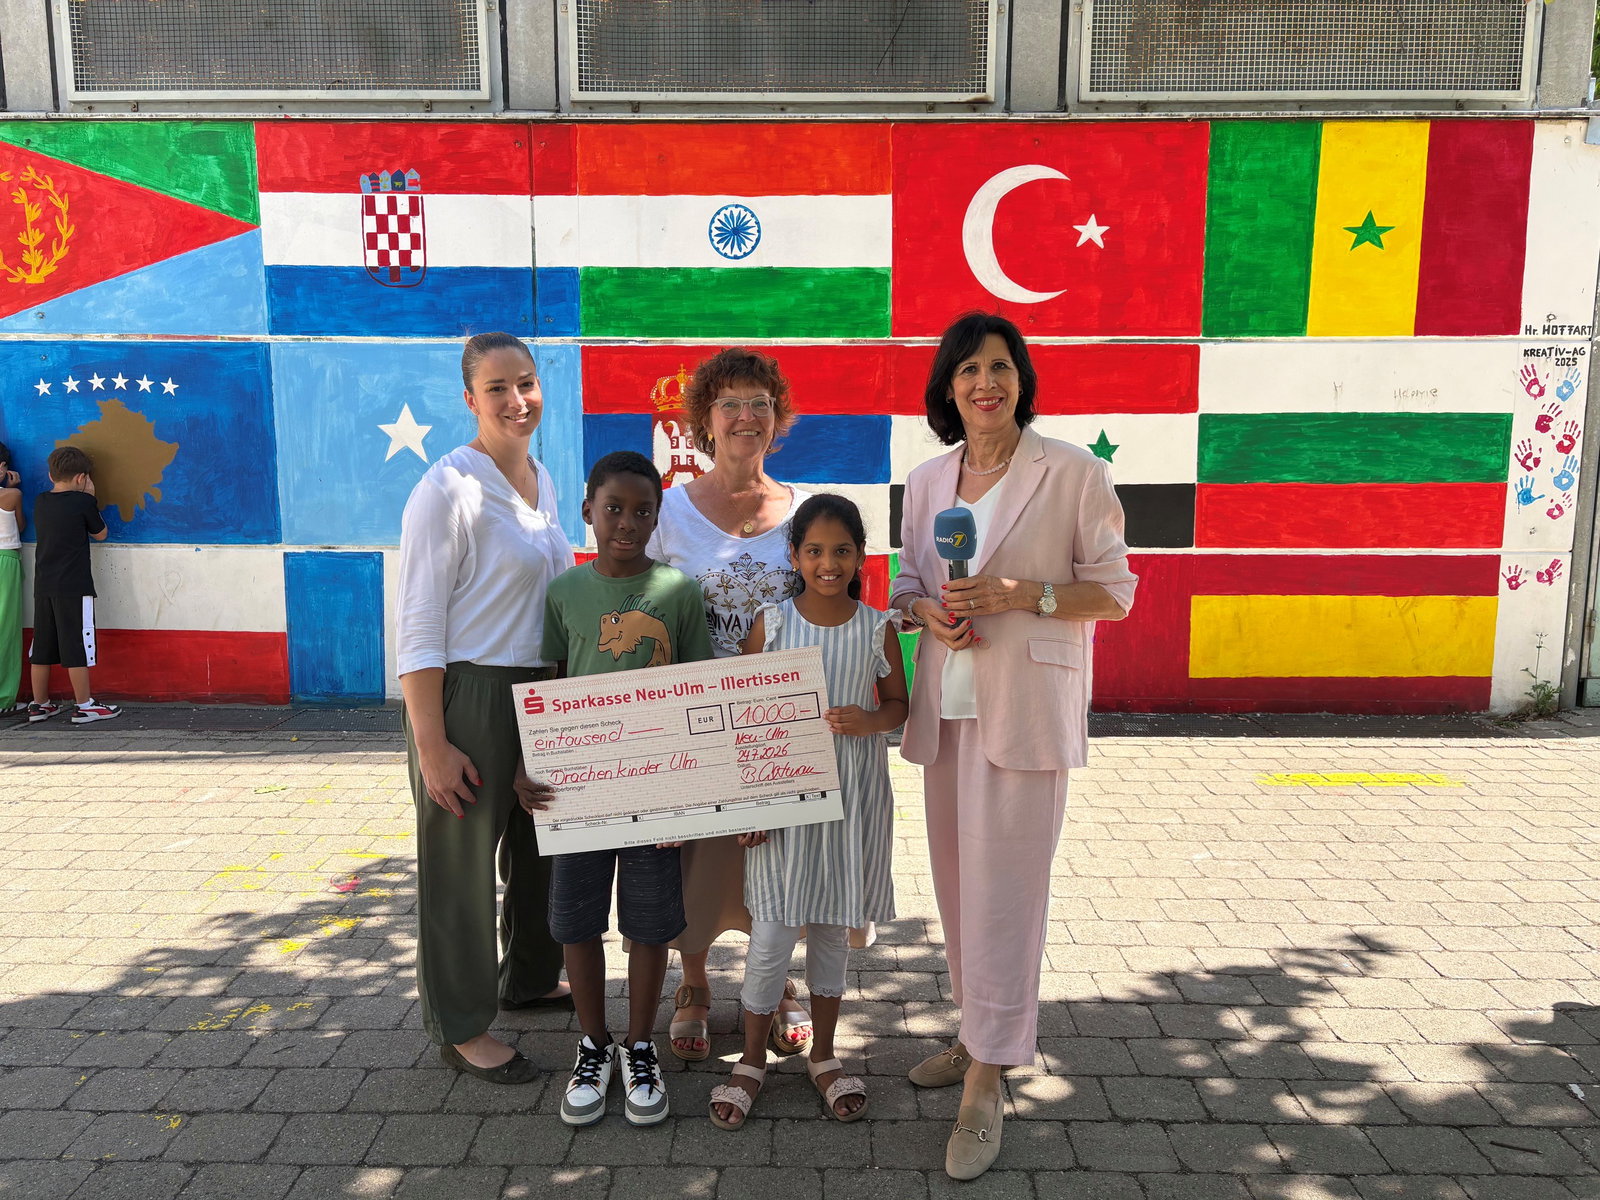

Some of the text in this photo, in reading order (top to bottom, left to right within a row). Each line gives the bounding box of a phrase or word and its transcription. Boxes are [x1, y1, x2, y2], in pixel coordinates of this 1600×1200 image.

[1525, 324, 1538, 336] Hr.
[1555, 357, 1578, 366] 2025
[936, 536, 954, 544] RADIO
[954, 534, 965, 546] 7
[552, 693, 632, 714] Sparkasse
[635, 681, 705, 702] Neu-Ulm
[720, 670, 801, 691] Illertissen
[698, 715, 714, 724] EUR
[528, 719, 621, 736] Zahlen Sie gegen diesen Scheck
[534, 723, 624, 751] eintausend
[669, 752, 698, 770] Ulm
